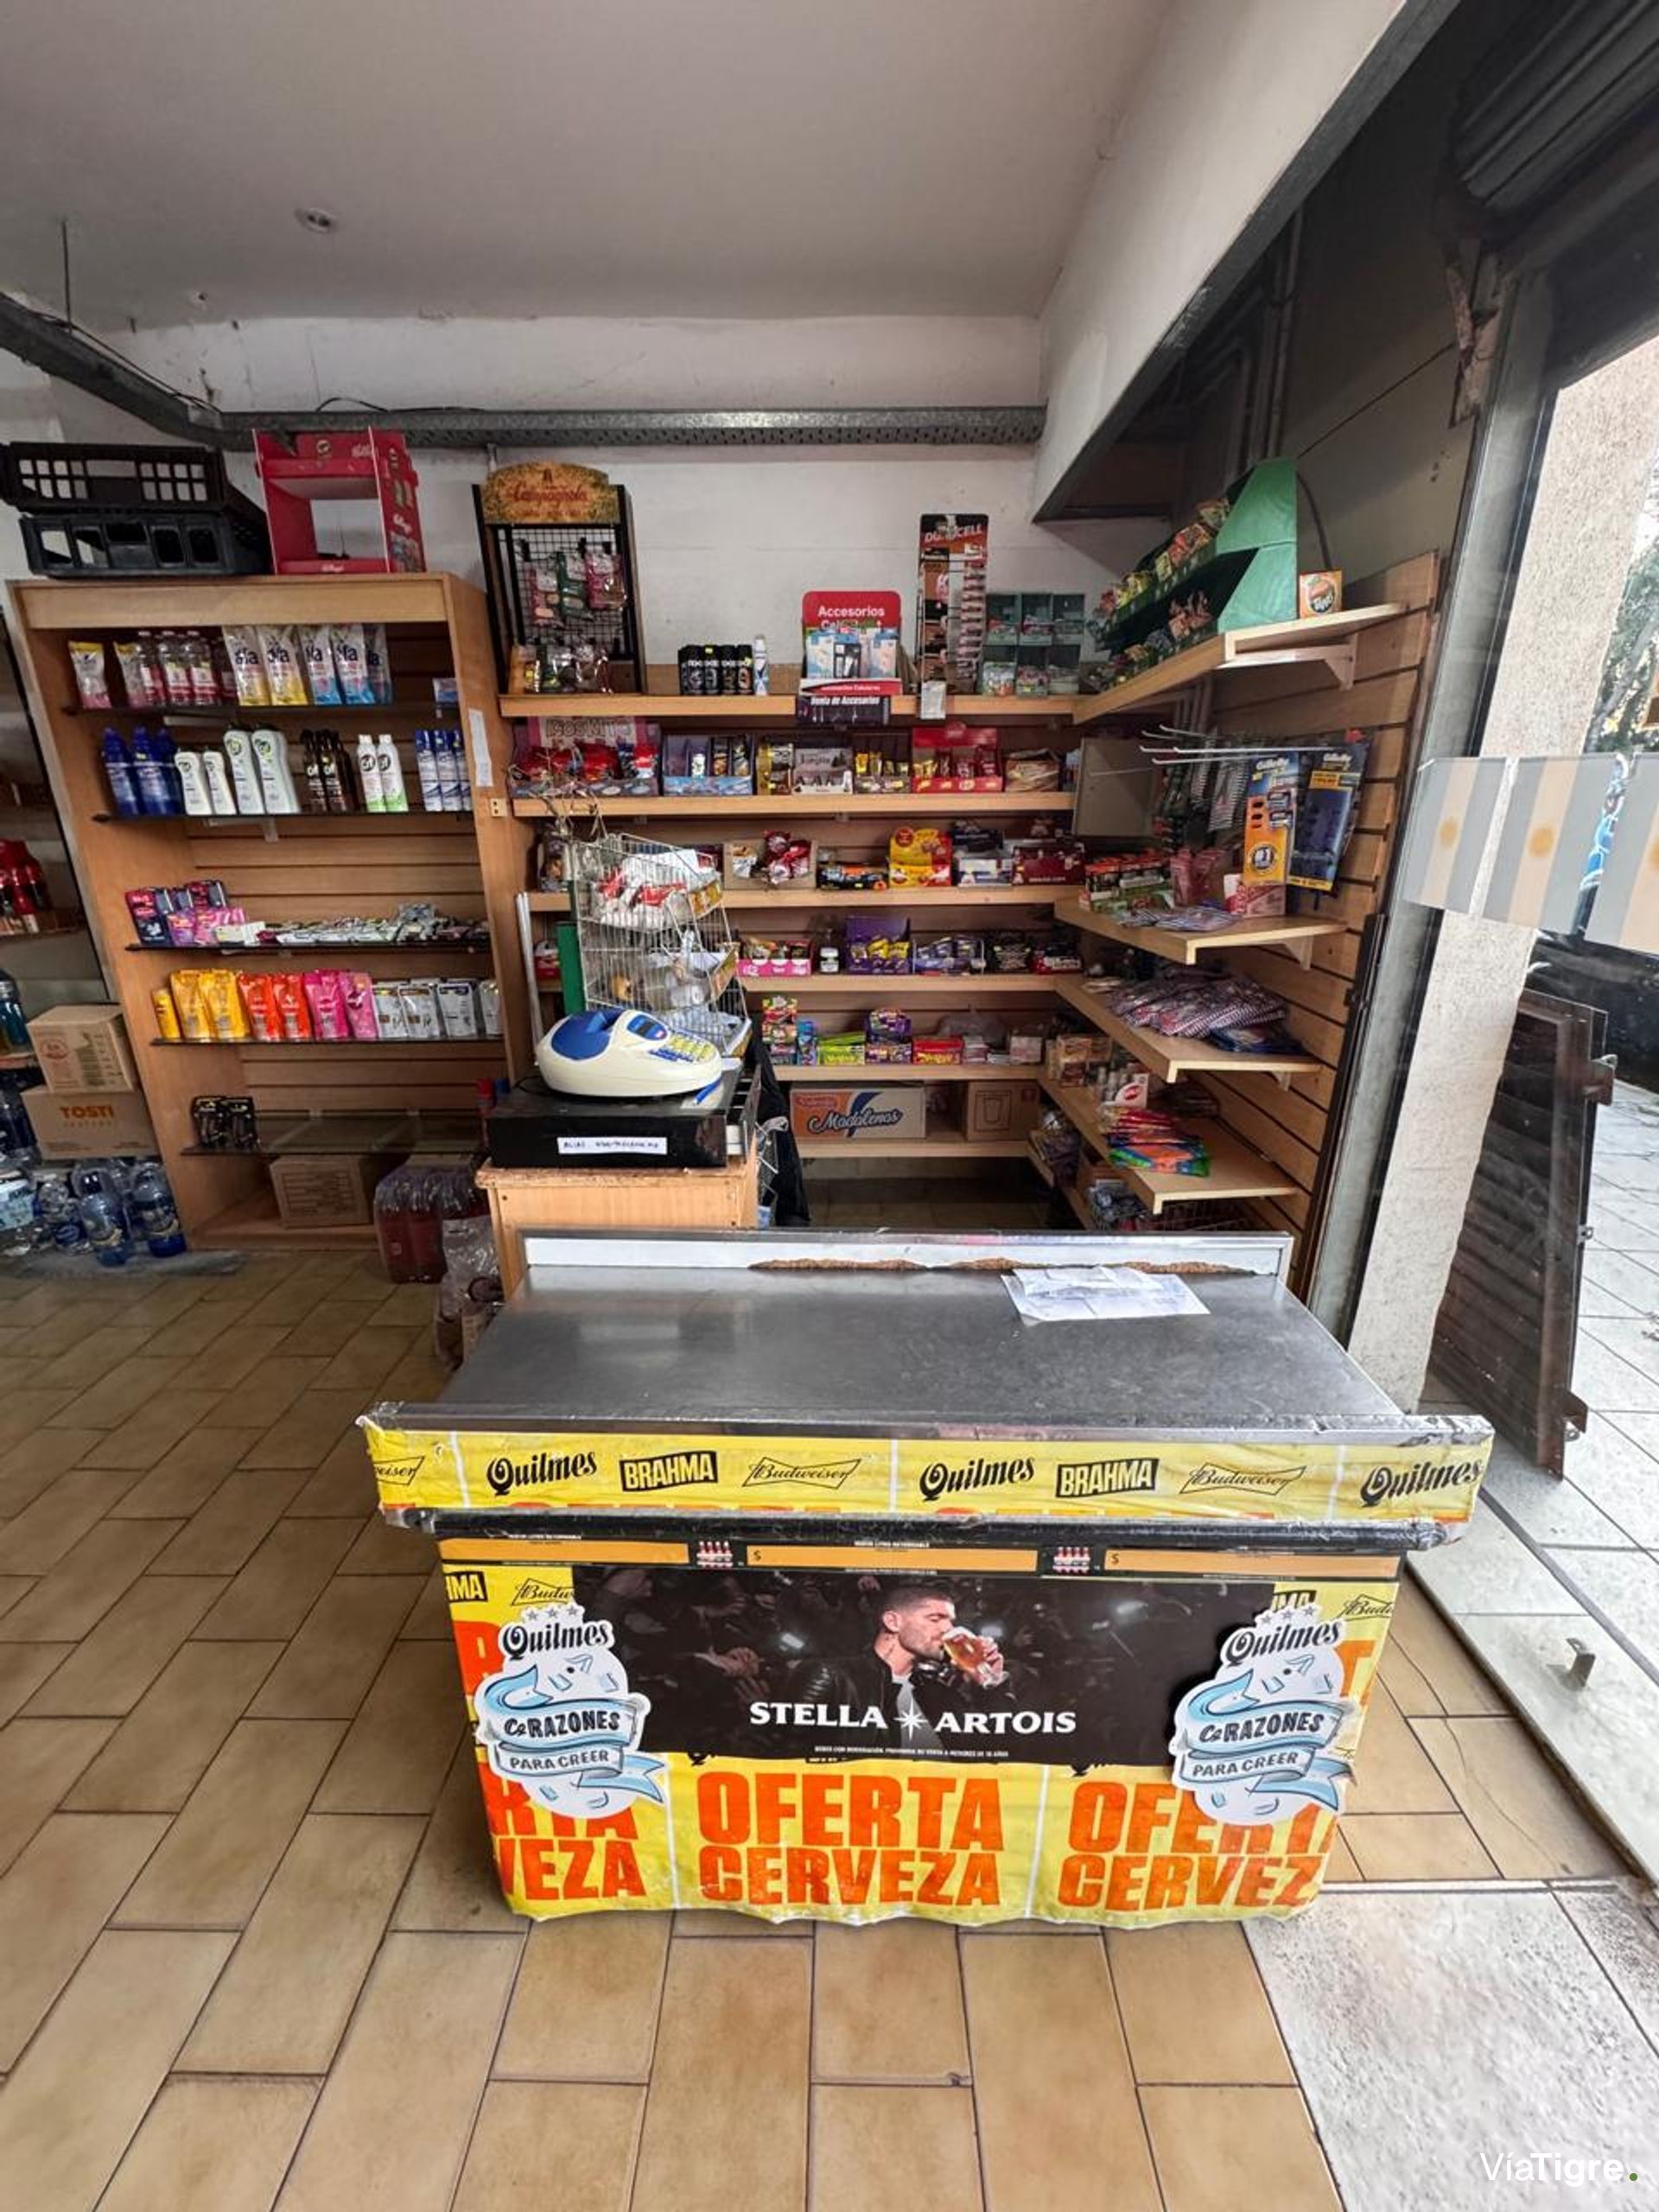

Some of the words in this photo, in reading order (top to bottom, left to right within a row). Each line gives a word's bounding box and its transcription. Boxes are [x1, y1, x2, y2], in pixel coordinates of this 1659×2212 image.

[817, 605, 885, 618] Accesorios
[60, 1105, 114, 1119] TOSTI
[486, 1452, 597, 1496] Quilmes
[623, 1453, 715, 1490] BRAHMA
[751, 1465, 851, 1479] Budweiser
[919, 1458, 1035, 1502] Quilmes
[1058, 1459, 1153, 1497] BRAHMA
[1190, 1469, 1290, 1486] Budweiser
[1360, 1459, 1483, 1507] Quilmes
[503, 1622, 608, 1660] Quilmes
[1226, 1621, 1341, 1667] Quilmes
[750, 1701, 888, 1729] STELLA
[935, 1712, 1077, 1734] ARTOIS
[510, 1755, 555, 1770] PARA
[558, 1751, 608, 1768] CREER
[1193, 1762, 1239, 1777] PARA
[1242, 1752, 1298, 1771] CREER
[697, 1771, 1003, 1851] OFERTA
[699, 1845, 1000, 1906] CERVEZA
